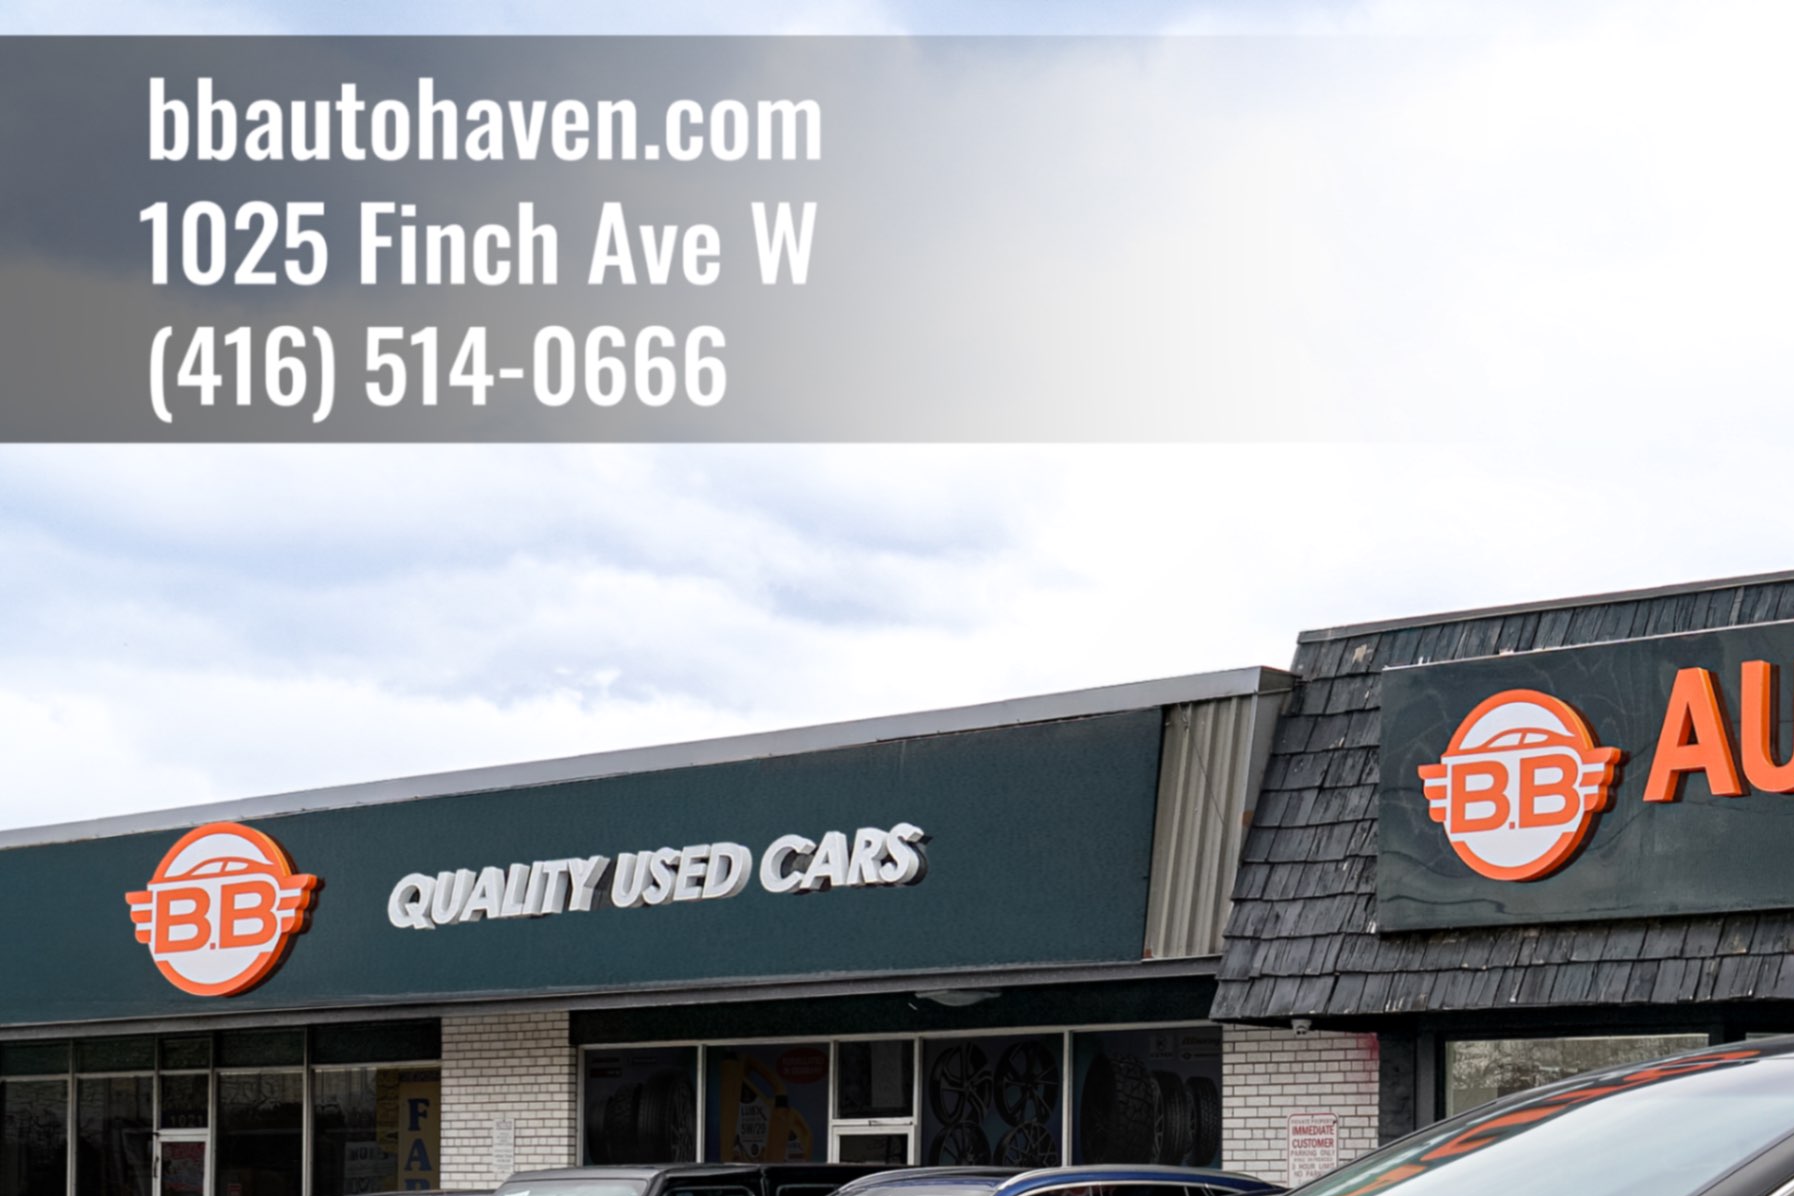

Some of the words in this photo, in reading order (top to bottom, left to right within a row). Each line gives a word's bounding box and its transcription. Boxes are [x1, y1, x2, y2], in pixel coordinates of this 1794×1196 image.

[388, 856, 611, 931] QUALITY
[611, 841, 753, 908] USED
[760, 822, 926, 895] CARS
[1292, 1125, 1335, 1136] IMMEDIATE
[1292, 1138, 1335, 1149] CUSTOMER
